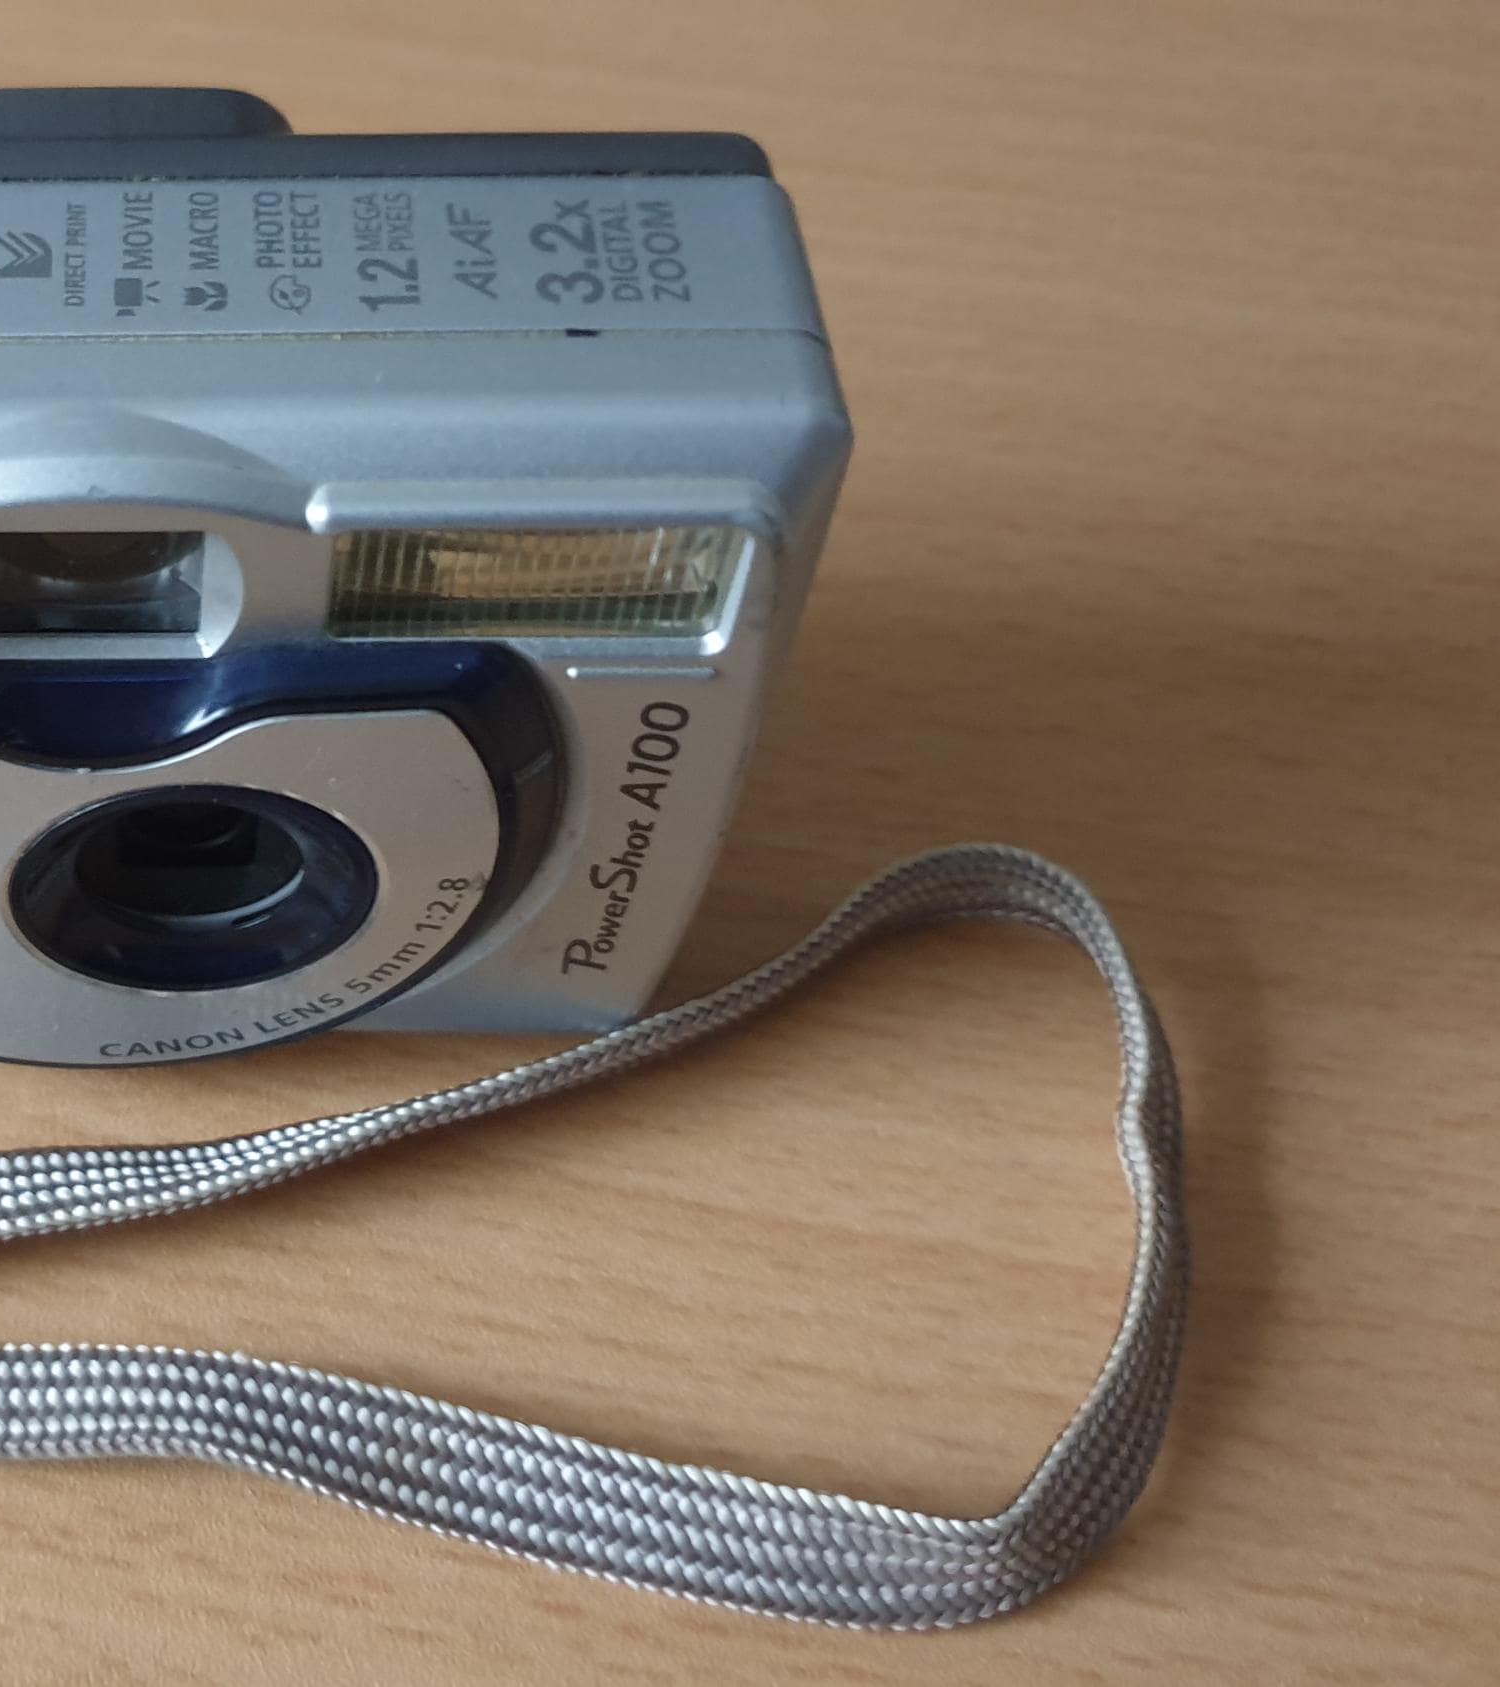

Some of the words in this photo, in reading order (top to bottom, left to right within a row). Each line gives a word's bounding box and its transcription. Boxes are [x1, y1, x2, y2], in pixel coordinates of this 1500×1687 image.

[66, 202, 87, 247] PRINT
[122, 190, 153, 270] MOVIE
[188, 191, 220, 270] MACRO
[252, 190, 285, 269] PHOTO
[289, 190, 323, 269] EFFECT
[353, 192, 382, 252] MEGA
[384, 191, 415, 252] PIXELS
[529, 200, 605, 304] 3.2x
[600, 200, 643, 302] DIGITAL
[637, 200, 692, 302] ZOOM
[63, 252, 87, 307] DIRECT
[356, 257, 421, 312] 1.2
[561, 816, 657, 977] PowerShot
[619, 700, 691, 812] A100
[99, 1027, 245, 1059] CANON
[257, 992, 346, 1036] LENS
[345, 940, 427, 998] 5mm
[414, 876, 471, 939] 1:2.8
